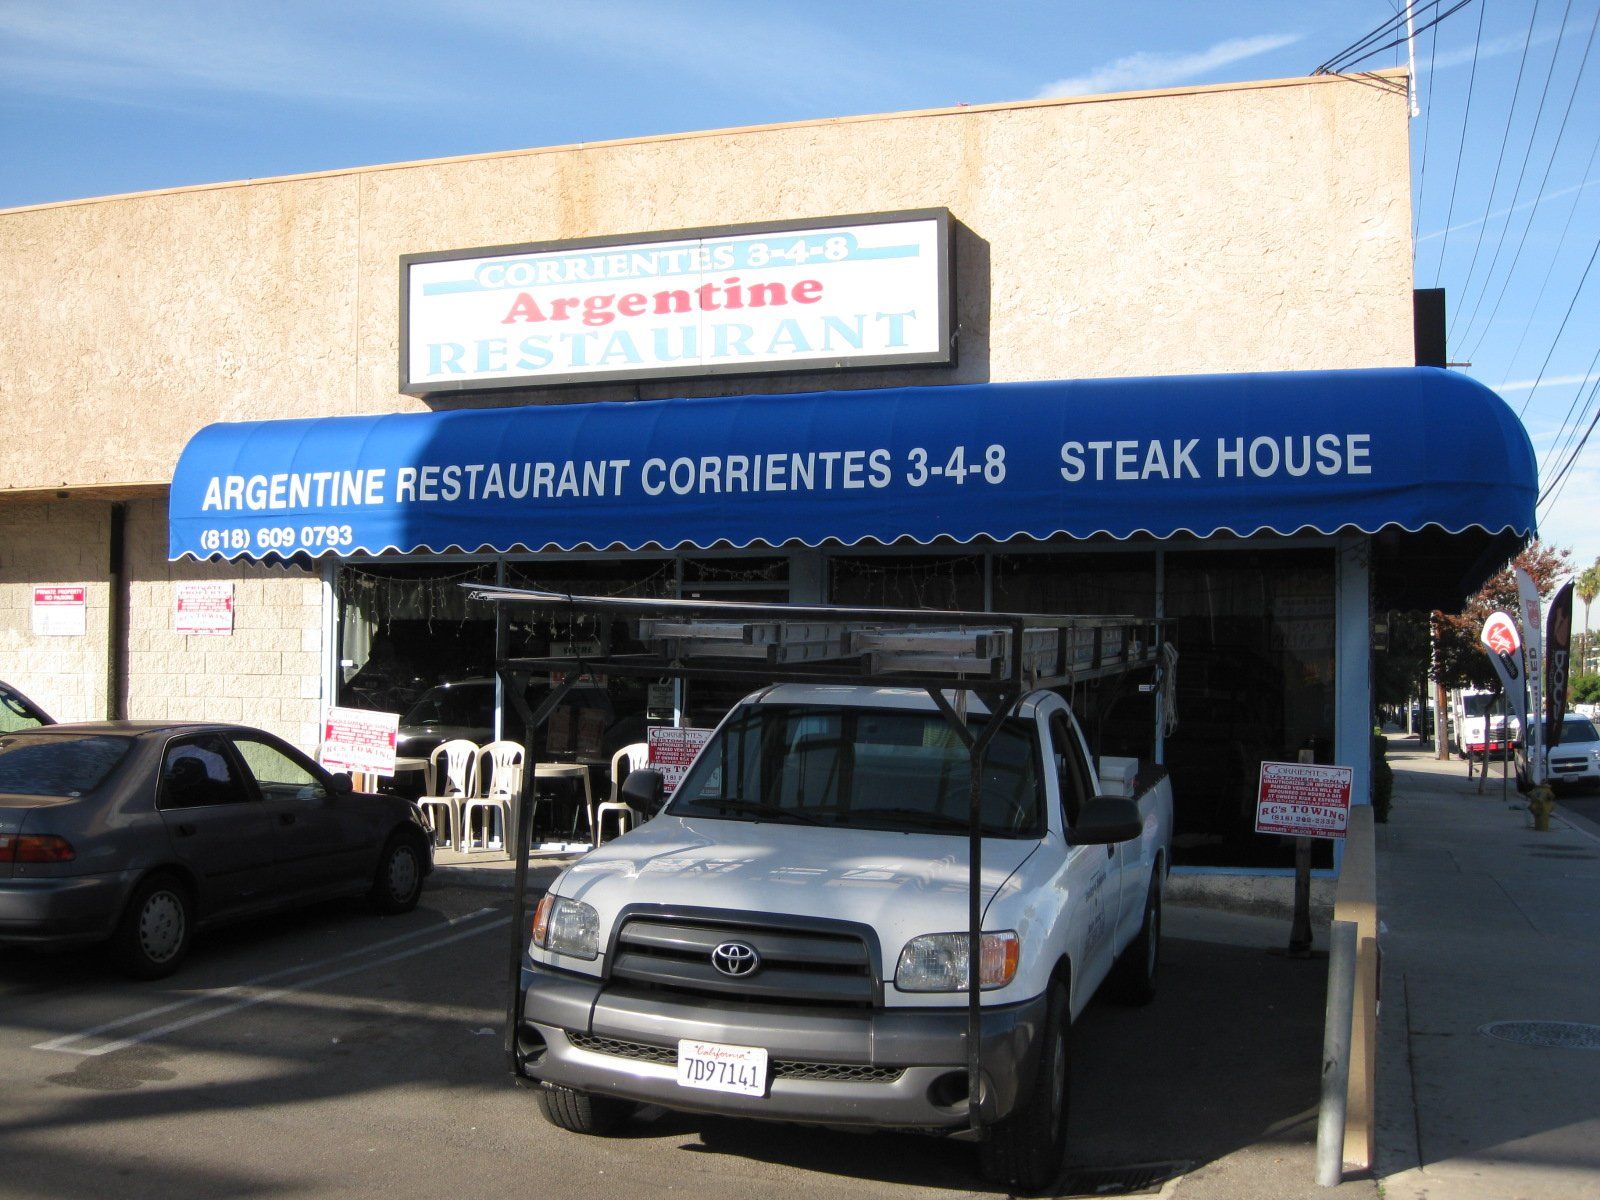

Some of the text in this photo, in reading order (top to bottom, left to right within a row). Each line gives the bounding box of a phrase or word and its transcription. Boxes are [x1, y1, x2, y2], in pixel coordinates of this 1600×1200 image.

[478, 236, 850, 289] CORRIENTES 3-4-8
[501, 277, 824, 328] Argentine
[426, 309, 917, 377] RESTAURANT
[201, 433, 1372, 511] ARGENTINE RESTAURANT CORRIENTES 3-4-8 STEAK HOUSE
[200, 525, 353, 550] (818) 609 0793
[1290, 805, 1345, 822] TOWING
[684, 1057, 759, 1088] 7D97141
[697, 1044, 746, 1060] California
